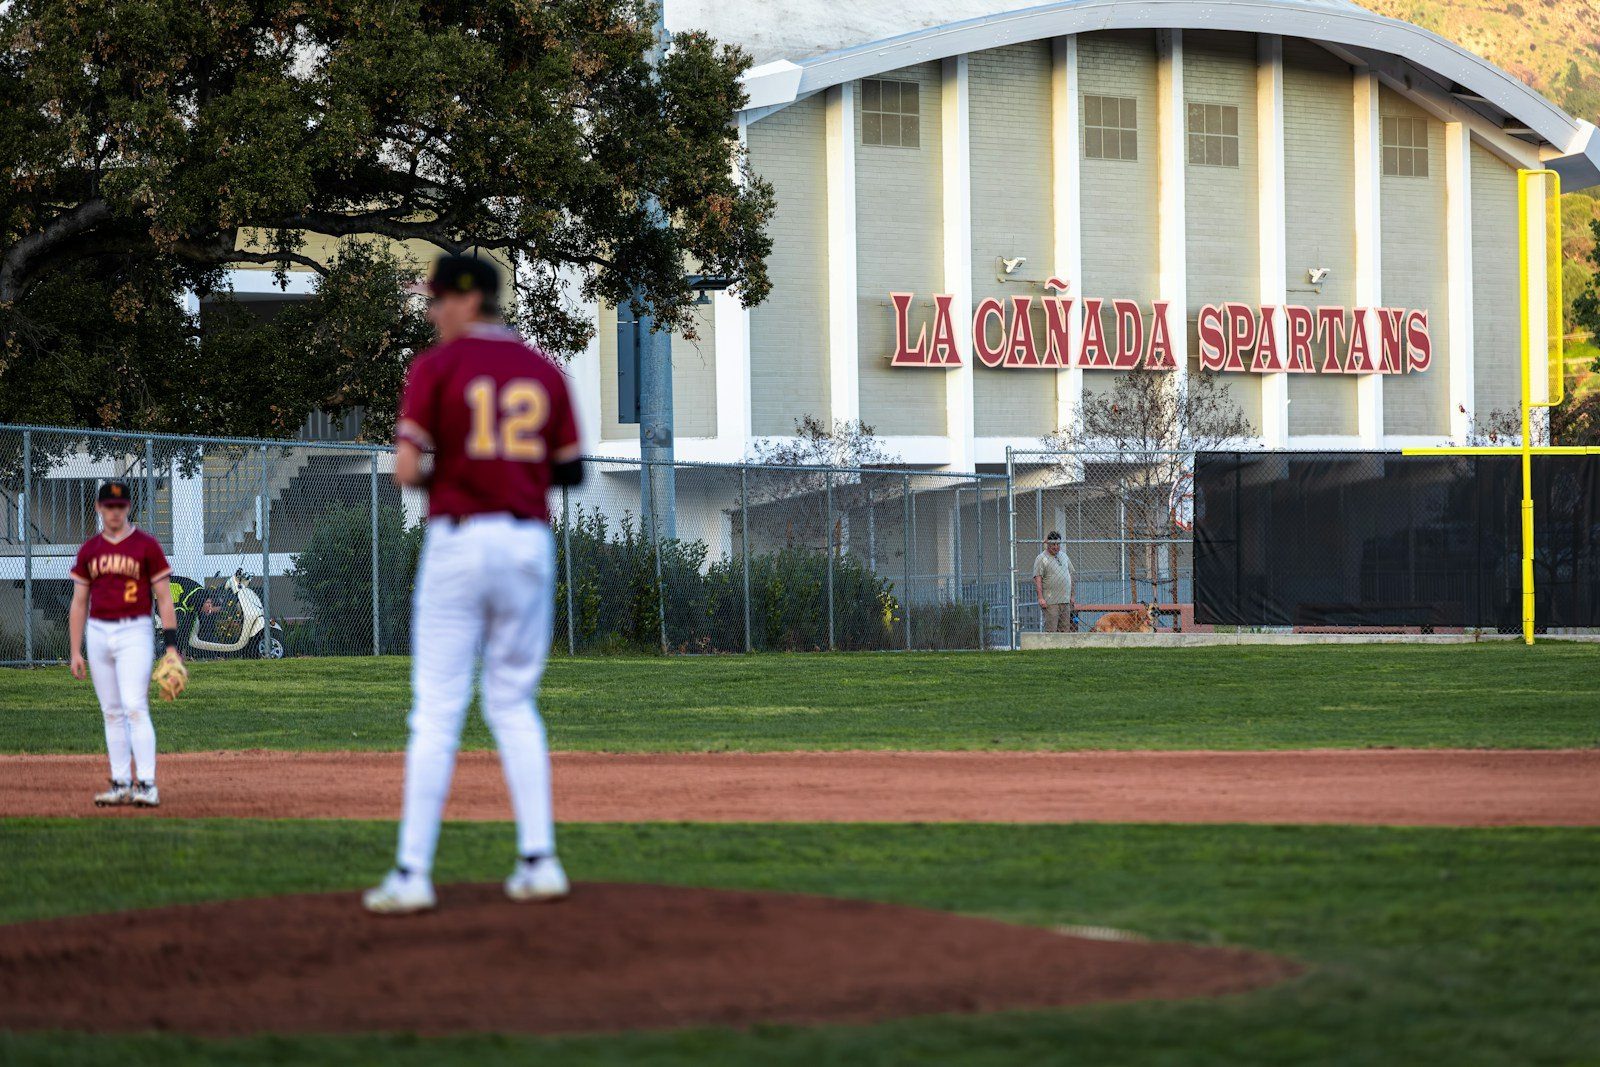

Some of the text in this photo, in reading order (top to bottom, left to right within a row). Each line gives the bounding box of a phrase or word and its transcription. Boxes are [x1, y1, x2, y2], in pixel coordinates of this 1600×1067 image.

[890, 276, 1432, 373] LA CAÑADA SPARTANS
[465, 376, 549, 461] 12
[124, 580, 138, 603] 2
